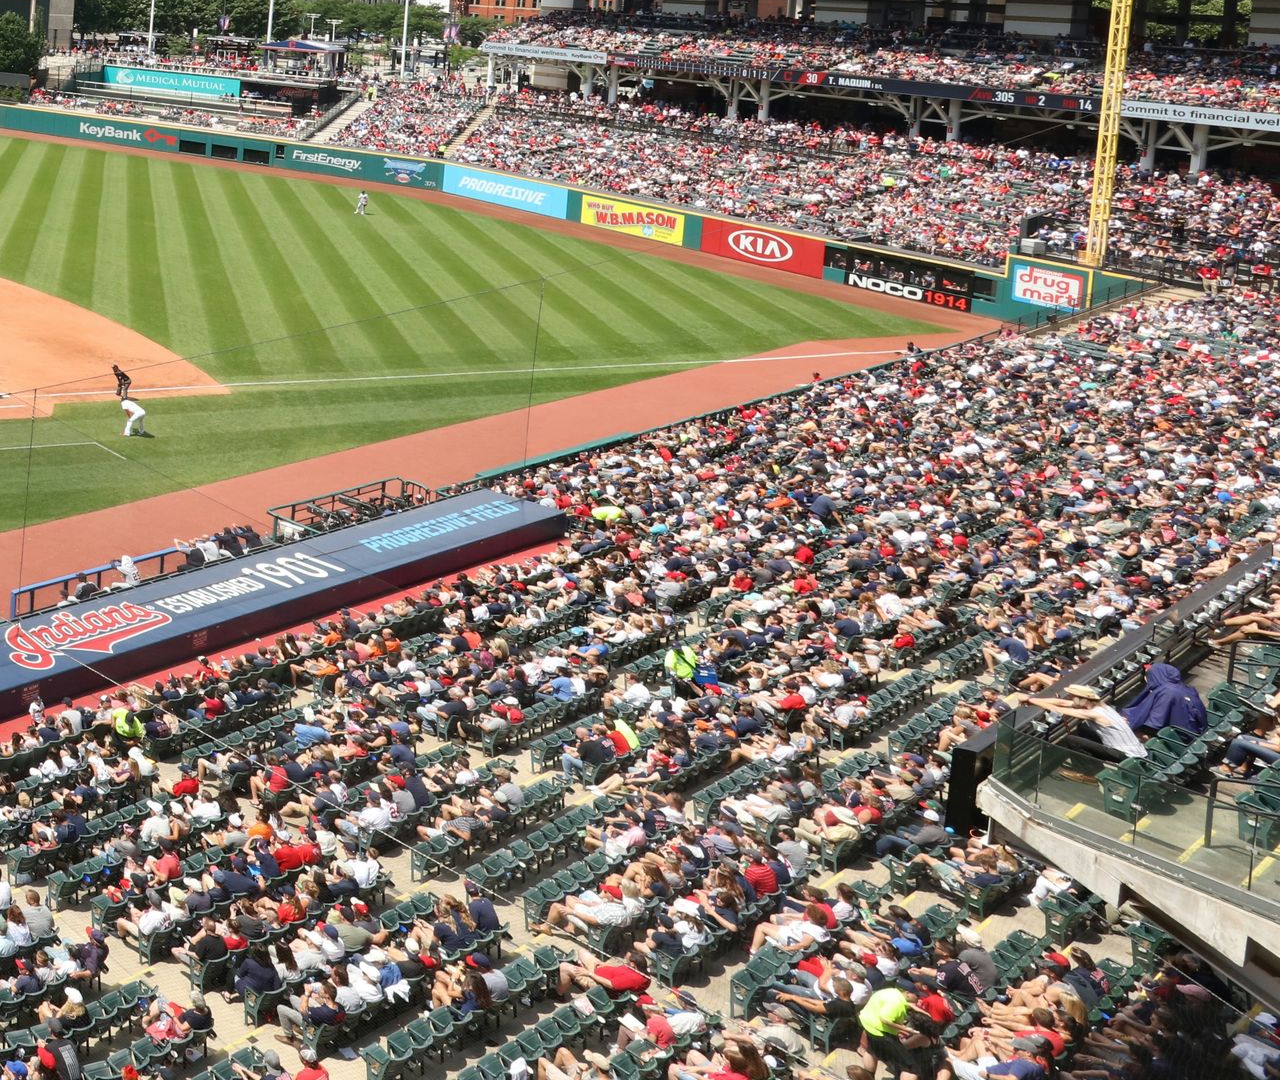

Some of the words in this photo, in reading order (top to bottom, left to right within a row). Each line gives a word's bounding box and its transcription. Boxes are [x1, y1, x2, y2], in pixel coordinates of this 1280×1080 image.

[484, 43, 505, 53] Commit
[514, 46, 539, 55] financial
[135, 73, 180, 87] MEDICAL
[182, 78, 224, 91] MUTUAL
[806, 73, 818, 83] 30
[838, 78, 871, 88] NAQUIN
[992, 91, 1015, 103] .305
[1079, 100, 1092, 111] 14
[1120, 104, 1168, 116] Commit
[1173, 109, 1186, 117] to
[1190, 110, 1249, 123] financial
[80, 121, 142, 141] KeyBank
[292, 149, 362, 170] FirstEnergy
[458, 175, 545, 205] PROGRESSIVE
[587, 201, 600, 209] WHO
[602, 203, 614, 211] BUY
[595, 210, 677, 230] W.B.MASON
[739, 234, 781, 258] KIA
[1019, 266, 1070, 294] drug
[848, 273, 923, 301] NOCO
[924, 291, 967, 310] 1914
[1022, 287, 1081, 308] mart
[359, 512, 477, 553] PROGRESSIVE
[463, 499, 520, 522] FIELD
[5, 601, 173, 670] Indians
[154, 576, 265, 614] ESTABLISHED
[241, 553, 346, 589] 1901
